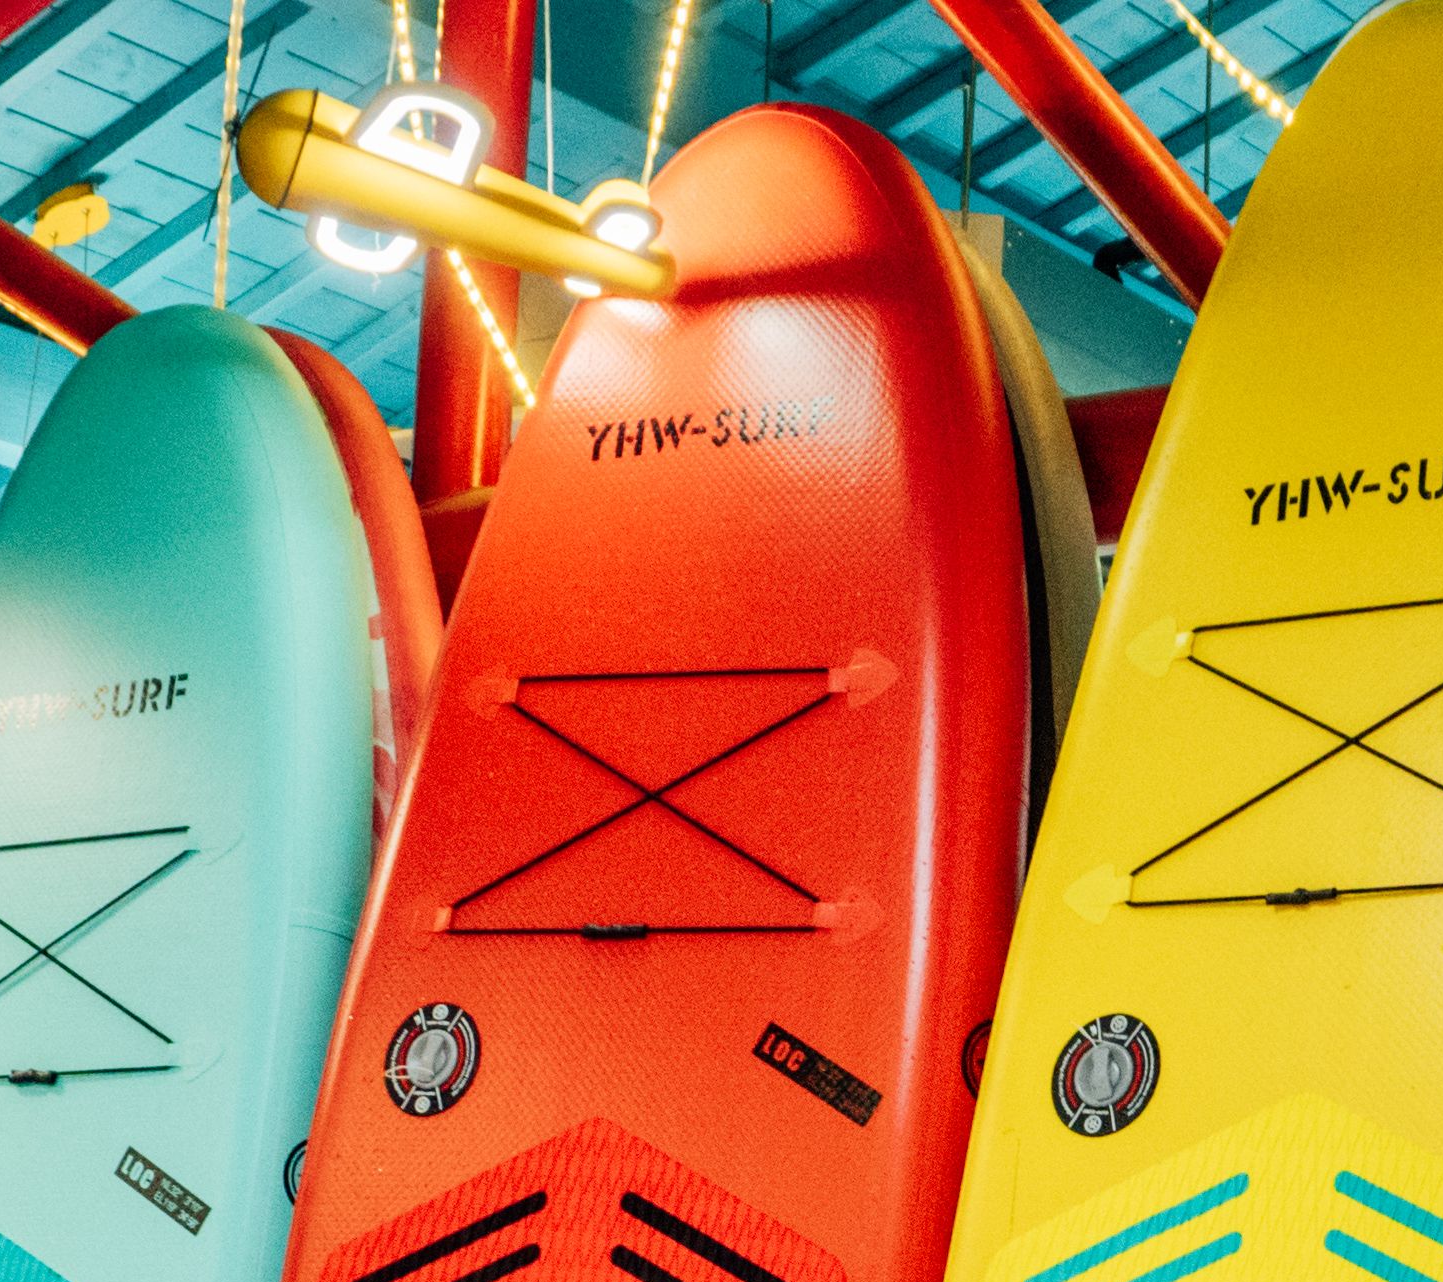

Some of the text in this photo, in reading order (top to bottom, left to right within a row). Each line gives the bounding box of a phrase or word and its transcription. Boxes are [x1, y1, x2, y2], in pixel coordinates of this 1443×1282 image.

[587, 398, 835, 462] YHW-SURF
[763, 1033, 806, 1072] LOC
[120, 1154, 155, 1189] LOC
